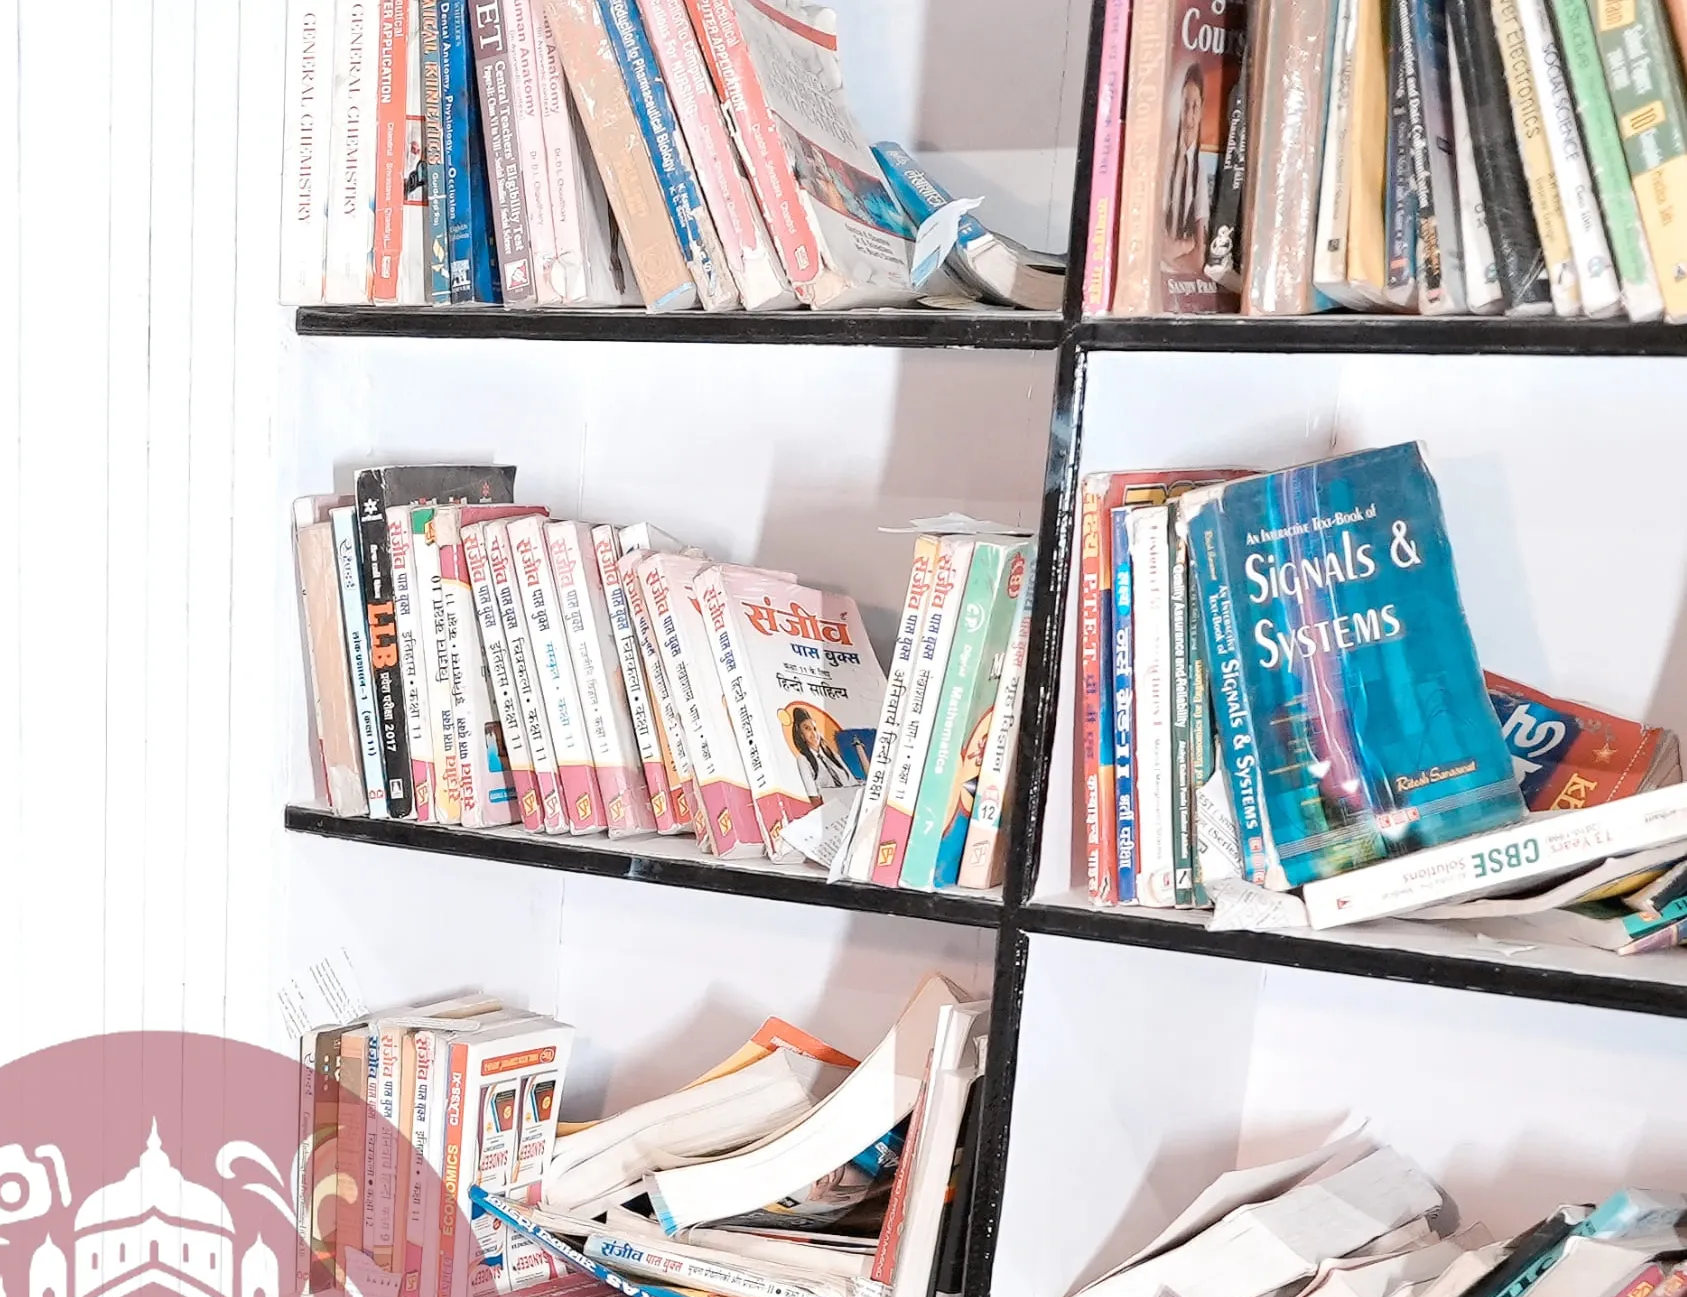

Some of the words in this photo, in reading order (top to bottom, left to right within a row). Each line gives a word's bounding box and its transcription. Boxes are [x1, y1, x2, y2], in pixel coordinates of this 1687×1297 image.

[438, 2, 452, 39] Dental
[299, 12, 317, 106] GENERAL
[346, 3, 364, 98] GENERAL
[378, 22, 395, 103] APPLICATION
[439, 42, 454, 91] Anatomy,
[679, 39, 712, 94] Computer
[710, 35, 747, 112] APPLICATION
[1539, 41, 1566, 93] SOCIAL
[491, 59, 509, 104] Central
[515, 47, 539, 118] Anatomy
[542, 43, 563, 113] Anatomy
[668, 60, 698, 115] NURSING
[1501, 30, 1546, 138] Electronics
[423, 62, 443, 164] KINETICS
[441, 95, 457, 153] Physiology,
[497, 107, 516, 159] Teachers'
[630, 58, 665, 133] Pharmaceutical
[653, 133, 676, 173] Biology
[1408, 97, 1422, 123] Data
[1552, 96, 1582, 162] SCIENCE
[295, 114, 314, 223] CHEMISTRY
[341, 105, 361, 217] CHEMISTRY
[1410, 125, 1432, 208] Communication
[445, 167, 459, 218] Occlusion
[502, 163, 524, 223] Eligibility
[511, 226, 526, 250] Test
[385, 519, 410, 569] संजीव
[1080, 493, 1098, 558] लक्ष्य
[1384, 518, 1421, 570] &
[1115, 571, 1131, 604] लक्ष्य
[1171, 564, 1184, 600] Quality
[367, 600, 402, 668] LLB
[430, 600, 446, 633] कक्षा
[742, 600, 852, 650] संजीव
[1081, 572, 1098, 664] P.T.E.T.
[1173, 602, 1186, 654] Assurance
[399, 629, 419, 676] इतिहास
[432, 639, 451, 682] विज्ञान
[488, 641, 511, 686] इतिहास
[510, 637, 535, 694] चित्रकला
[540, 640, 562, 680] संस्कृत
[618, 634, 644, 692] चित्रकला
[955, 643, 973, 677] Digital
[1116, 626, 1133, 675] नर्स
[406, 688, 421, 718] कक्षा
[448, 654, 465, 706] इतिहास
[727, 676, 747, 703] हिन्दी
[777, 678, 809, 697] हिन्दी
[813, 681, 850, 700] साहित्य
[883, 669, 909, 727] अनिवार्य
[910, 667, 933, 714] लेखाशास्त्र
[1173, 678, 1187, 727] Reliability
[383, 723, 397, 751] 2017
[735, 704, 757, 739] साहित्य
[932, 685, 963, 774] Mathematics
[990, 713, 1015, 773] विज्ञान
[1232, 732, 1251, 750] &
[875, 731, 896, 765] हिन्दी
[441, 755, 460, 803] संजीव
[457, 762, 476, 811] संजीव
[1119, 826, 1135, 865] परीक्षा
[1470, 841, 1542, 879] CBSE
[1548, 834, 1591, 855] Years
[1401, 857, 1465, 883] Solutions
[448, 1072, 462, 1126] CLASS-XI
[413, 1130, 427, 1164] इतिहास
[480, 1150, 509, 1172] SANDEEP
[519, 1139, 546, 1161] SANDEEP
[441, 1144, 460, 1235] ECONOMICS
[480, 1190, 539, 1233] विज्ञान
[513, 1253, 550, 1273] SANDEEP
[534, 1226, 600, 1273] सामान्य
